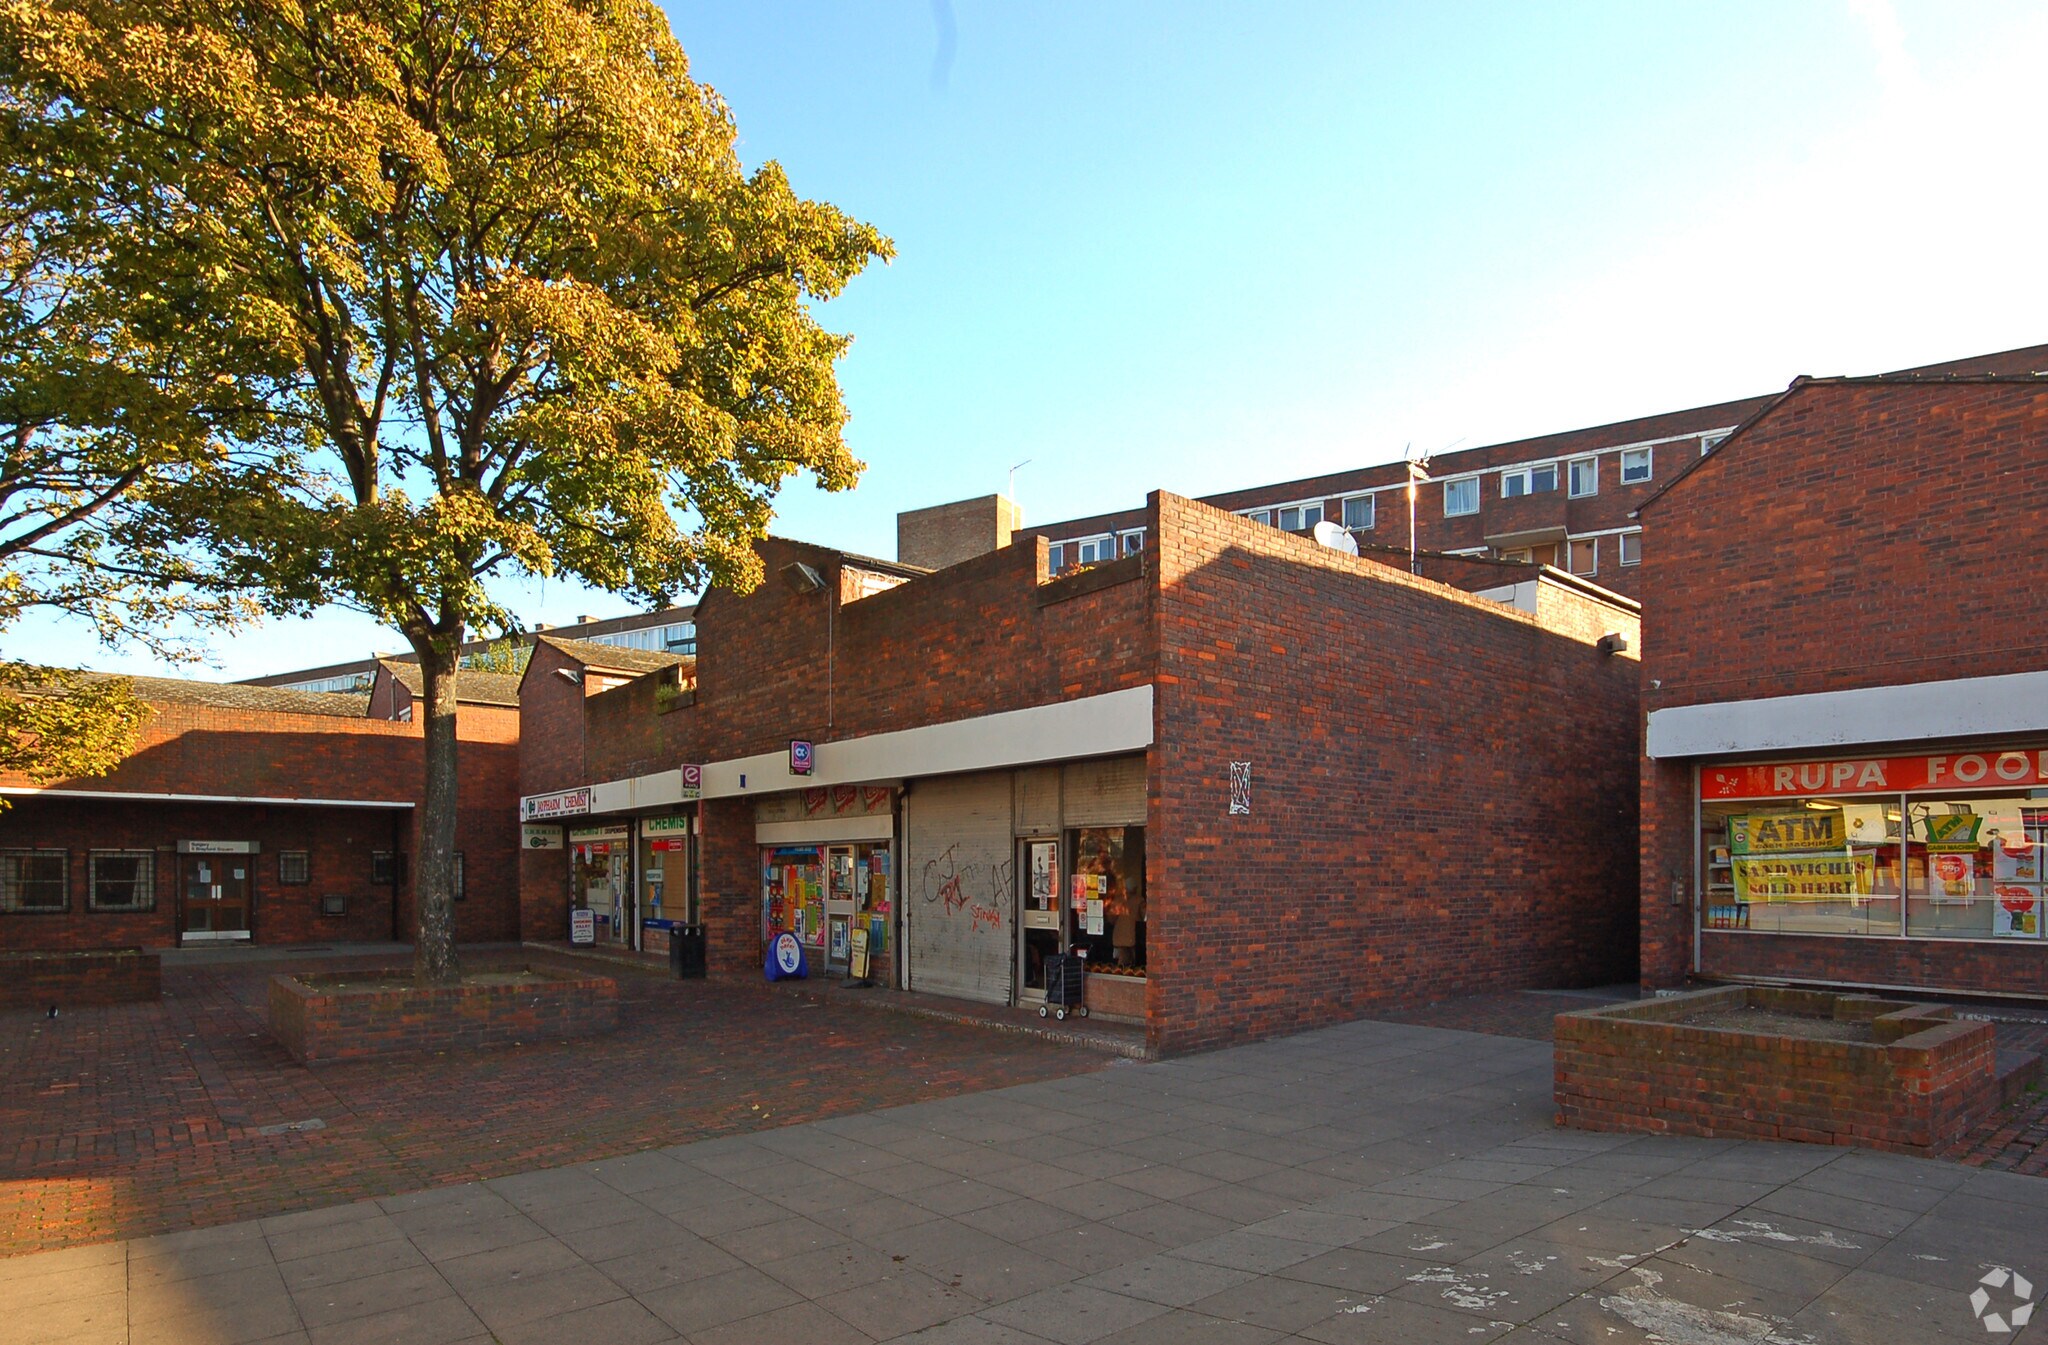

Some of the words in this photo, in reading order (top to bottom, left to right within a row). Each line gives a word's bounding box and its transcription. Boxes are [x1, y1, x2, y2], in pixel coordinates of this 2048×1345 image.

[1774, 761, 1887, 792] RUPA
[1756, 816, 1834, 843] ATM
[1937, 815, 1963, 839] ATM
[1739, 860, 1867, 878] SANDWICHES
[1941, 864, 1961, 873] 99p
[1749, 881, 1797, 895] SOLD
[1801, 880, 1857, 895] HERE
